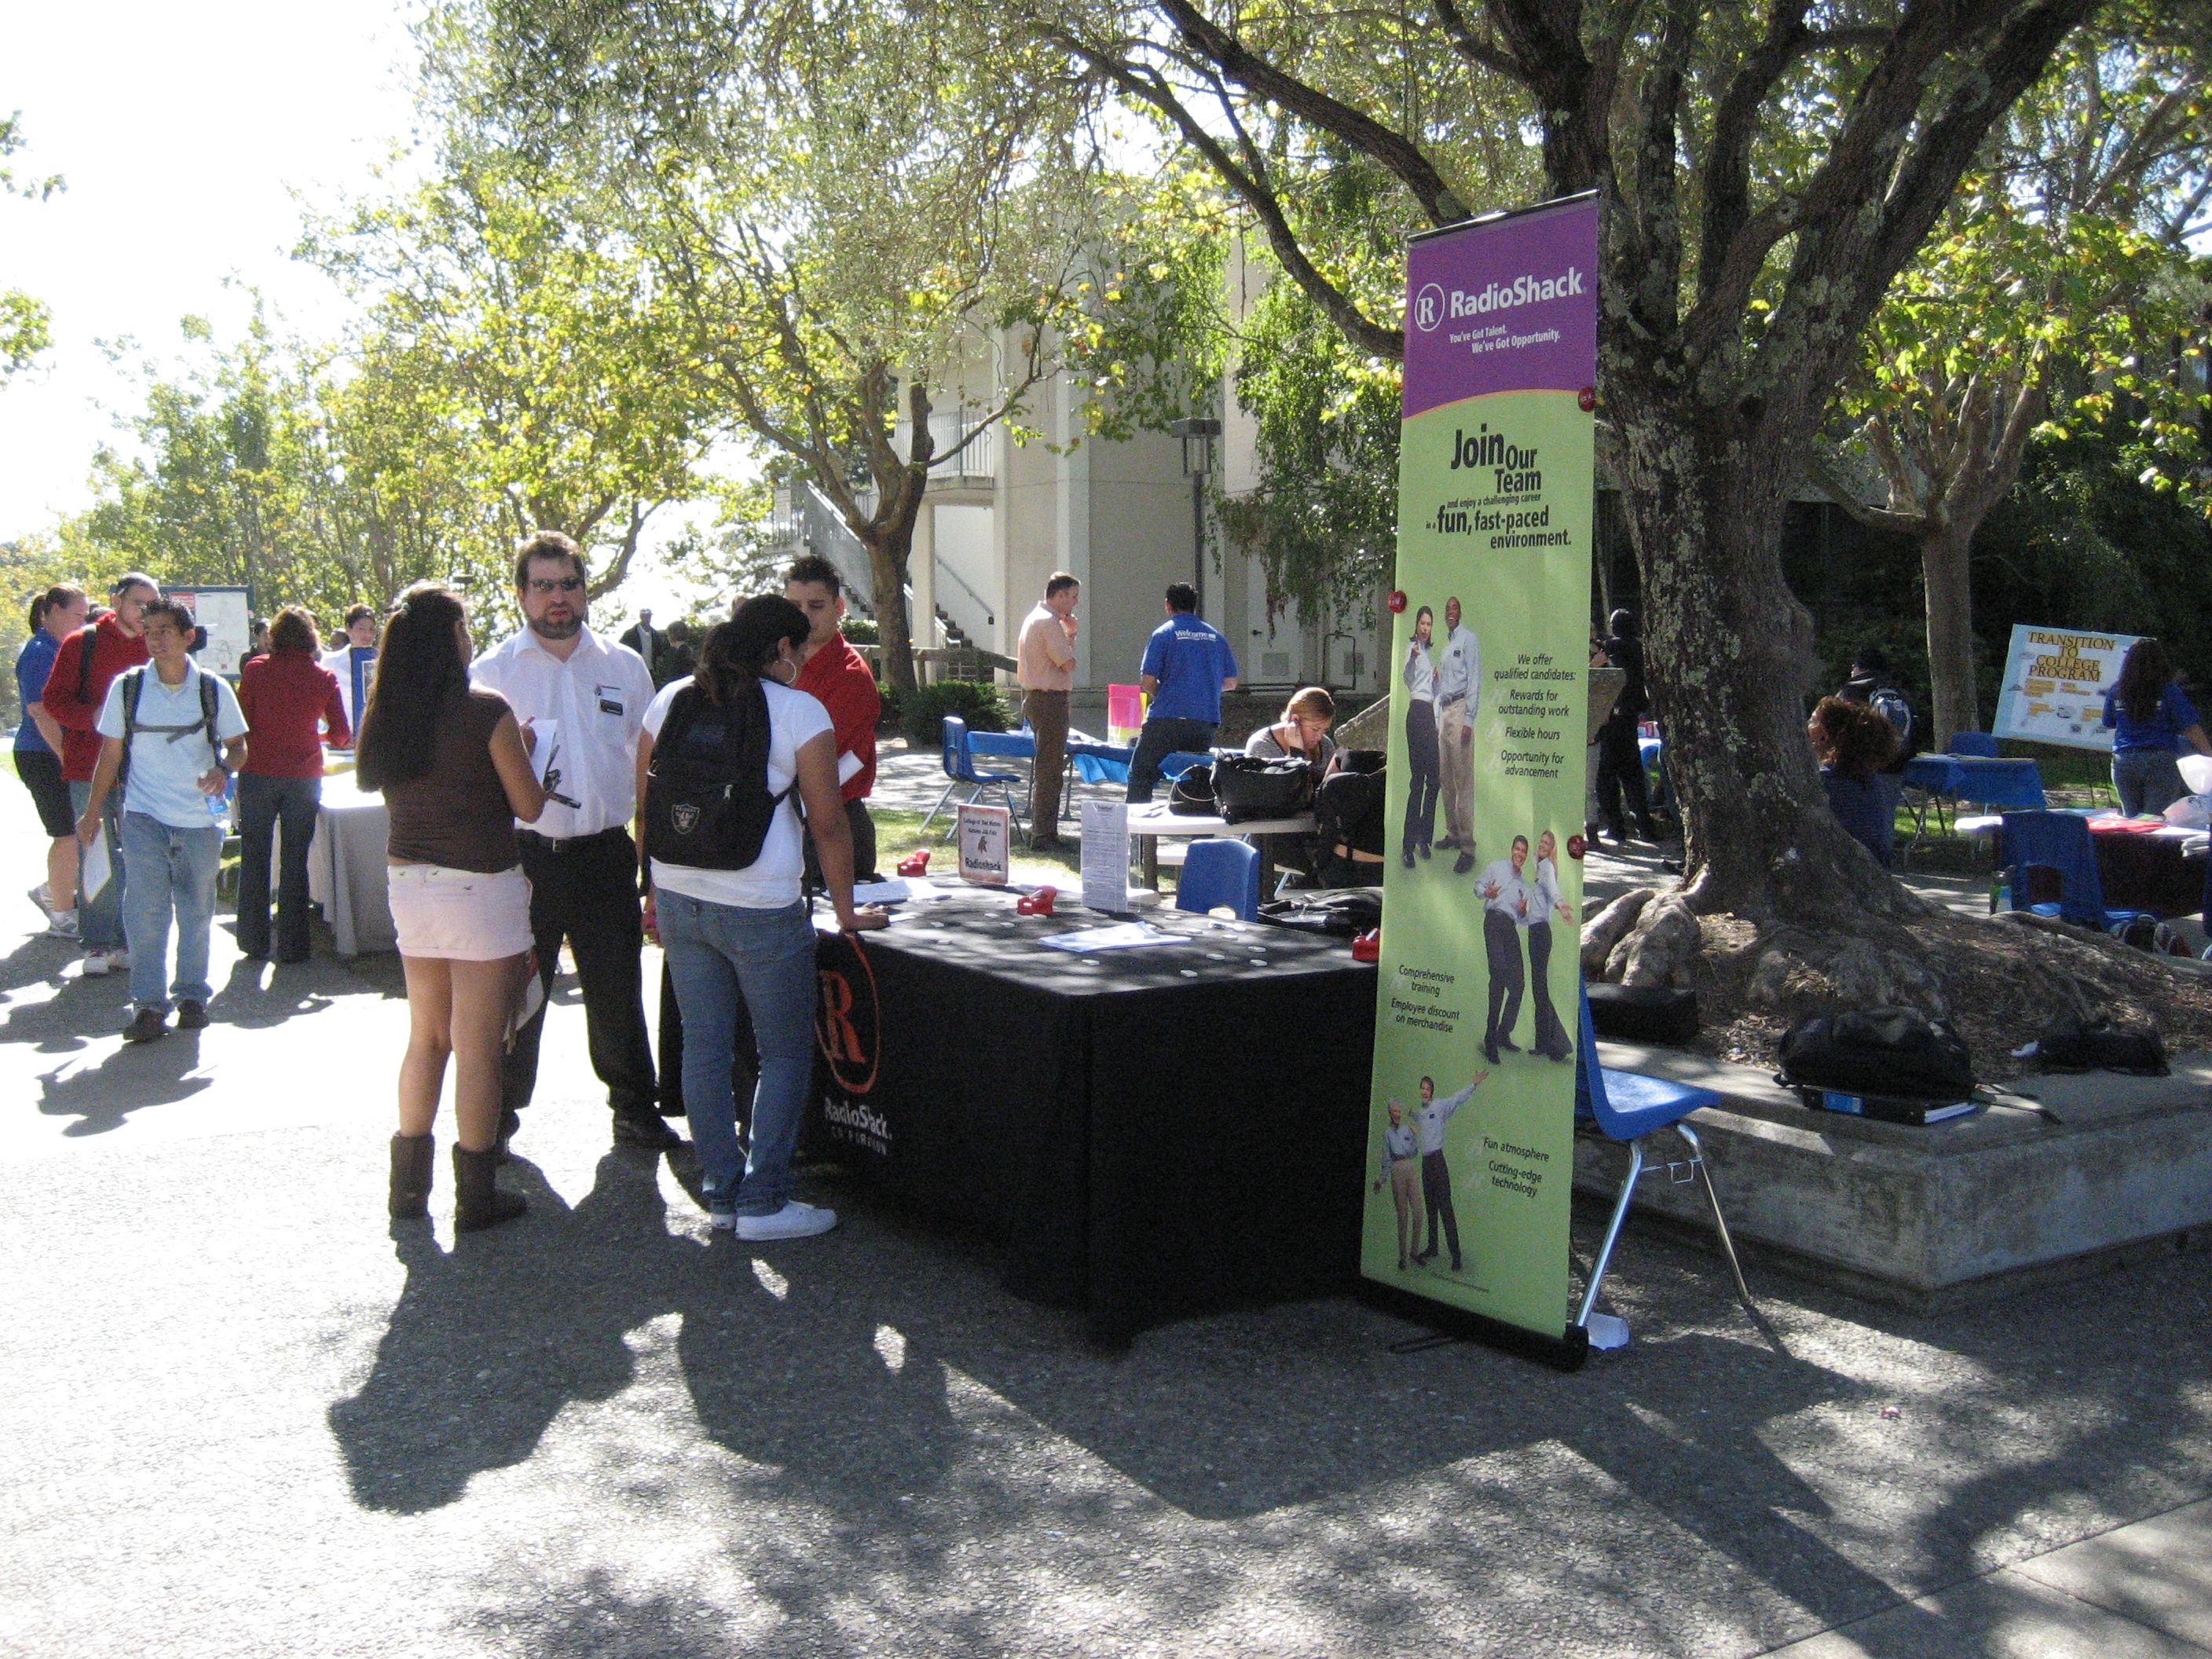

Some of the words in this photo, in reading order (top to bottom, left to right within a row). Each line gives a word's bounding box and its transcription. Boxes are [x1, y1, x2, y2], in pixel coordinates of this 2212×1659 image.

[1450, 267, 1583, 318] RadioShack
[1449, 331, 1470, 343] You've
[1472, 327, 1485, 339] Got
[1485, 324, 1507, 338] Talent.
[1472, 339, 1493, 353] We've
[1496, 335, 1510, 349] Got
[1511, 328, 1561, 348] Opportunity.
[1451, 423, 1504, 470] Join
[1495, 468, 1541, 493] Team
[1447, 496, 1459, 508] and
[1459, 497, 1476, 509] enjoy
[1478, 498, 1482, 507] a
[1483, 493, 1519, 506] challenging
[1521, 493, 1541, 503] career
[1437, 505, 1472, 535] fun,
[1474, 505, 1549, 534] fast-paced
[1491, 529, 1571, 549] environment.
[2029, 632, 2116, 650] TRANSITION
[1518, 654, 1530, 665] We
[1533, 654, 1553, 665] offer
[2060, 646, 2078, 658] TO
[2037, 655, 2100, 671] COLLEGE
[1494, 668, 1529, 681] qualified
[2029, 665, 2102, 682] PROGRAM
[1510, 689, 1544, 701] Rewards
[1546, 690, 1558, 701] for
[1498, 705, 1546, 718] outstanding
[1548, 705, 1569, 716] work
[1505, 727, 1535, 738] Flexible
[1537, 727, 1561, 740] hours
[1501, 749, 1550, 766] Opportunity
[1551, 752, 1564, 764] for
[1505, 764, 1558, 778] advancement
[1399, 965, 1455, 983] Comprehensive
[1411, 981, 1441, 997] training
[1391, 998, 1426, 1014] Employee
[1427, 1005, 1459, 1020] discount
[1396, 1014, 1404, 1023] on
[1407, 1016, 1453, 1033] merchandise
[1484, 1137, 1499, 1151] Fun
[1500, 1142, 1550, 1163] atmosphere
[1489, 1159, 1543, 1184] Cutting-edge
[1492, 1175, 1538, 1199] technology
